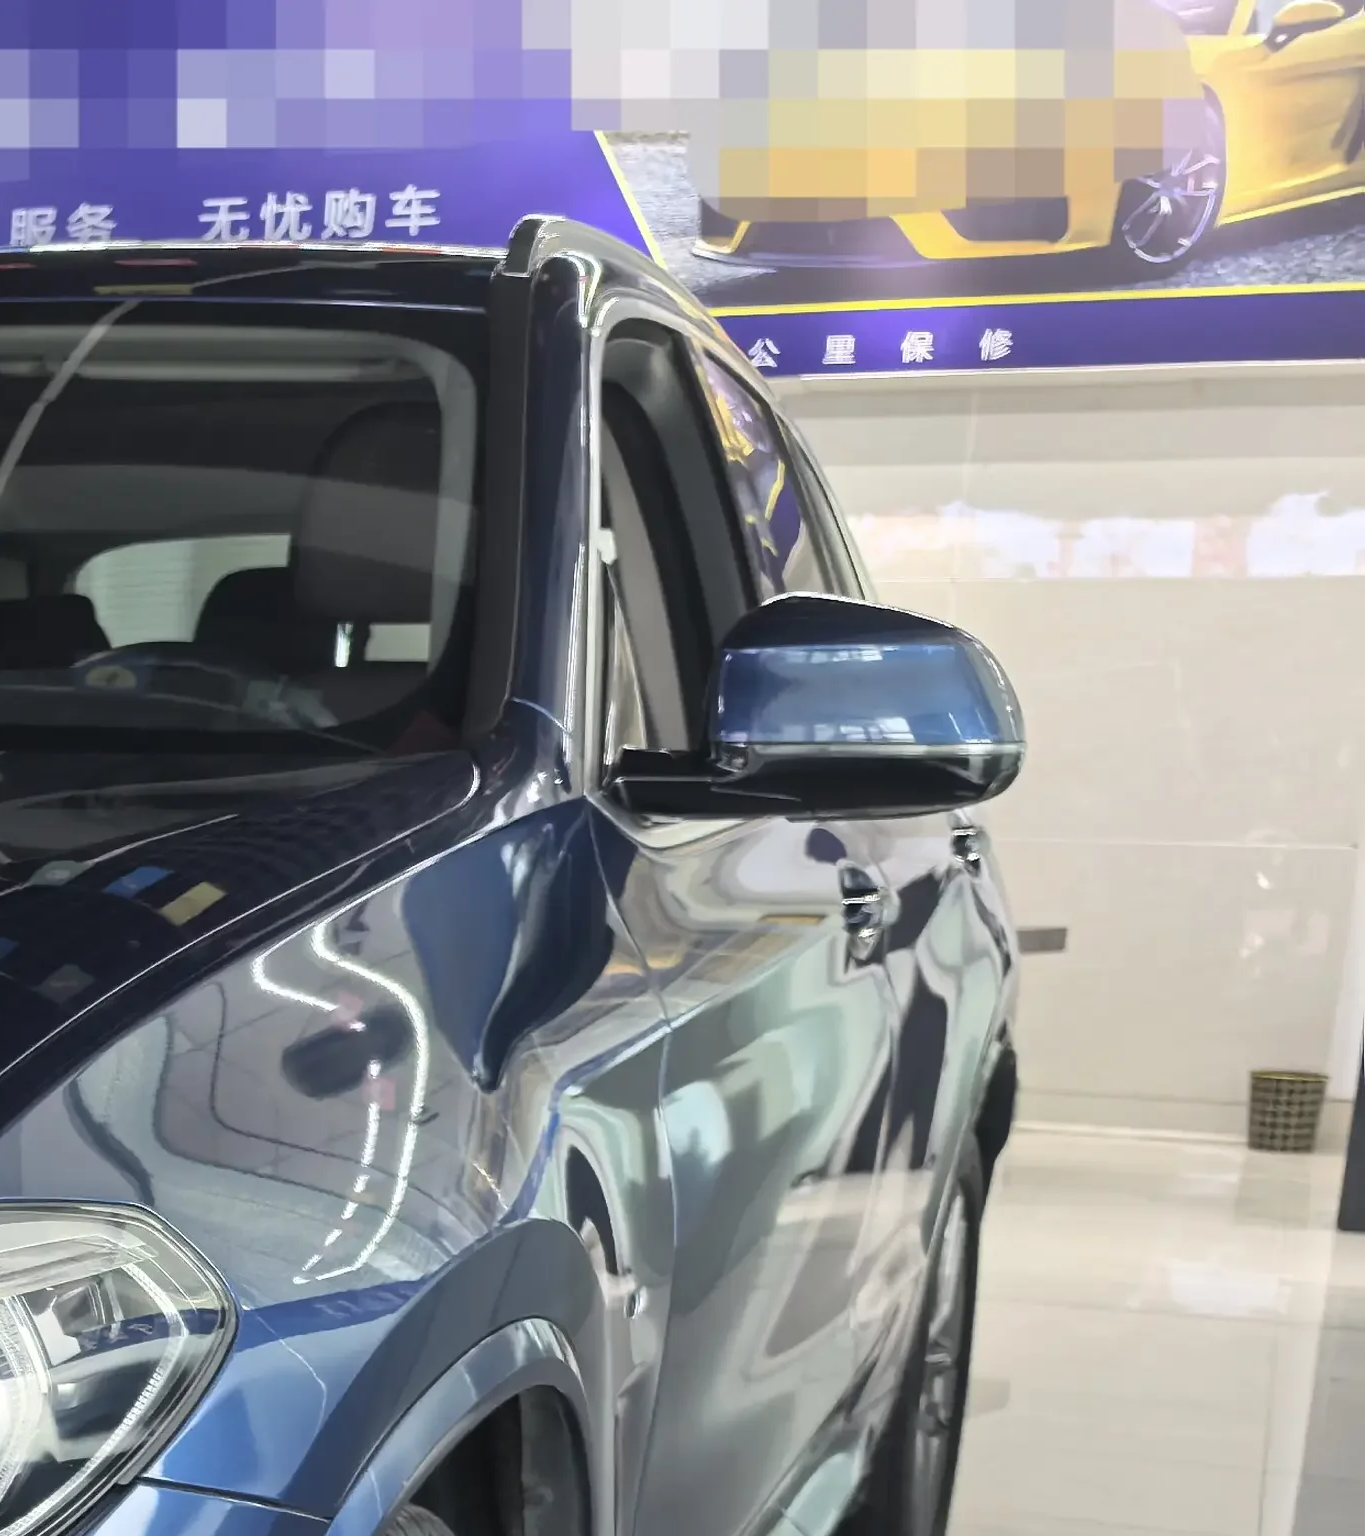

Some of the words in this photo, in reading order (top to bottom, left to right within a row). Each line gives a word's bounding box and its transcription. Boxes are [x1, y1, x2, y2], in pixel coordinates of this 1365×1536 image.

[197, 183, 441, 241] 无忧购车
[748, 328, 1014, 368] 公里保修
